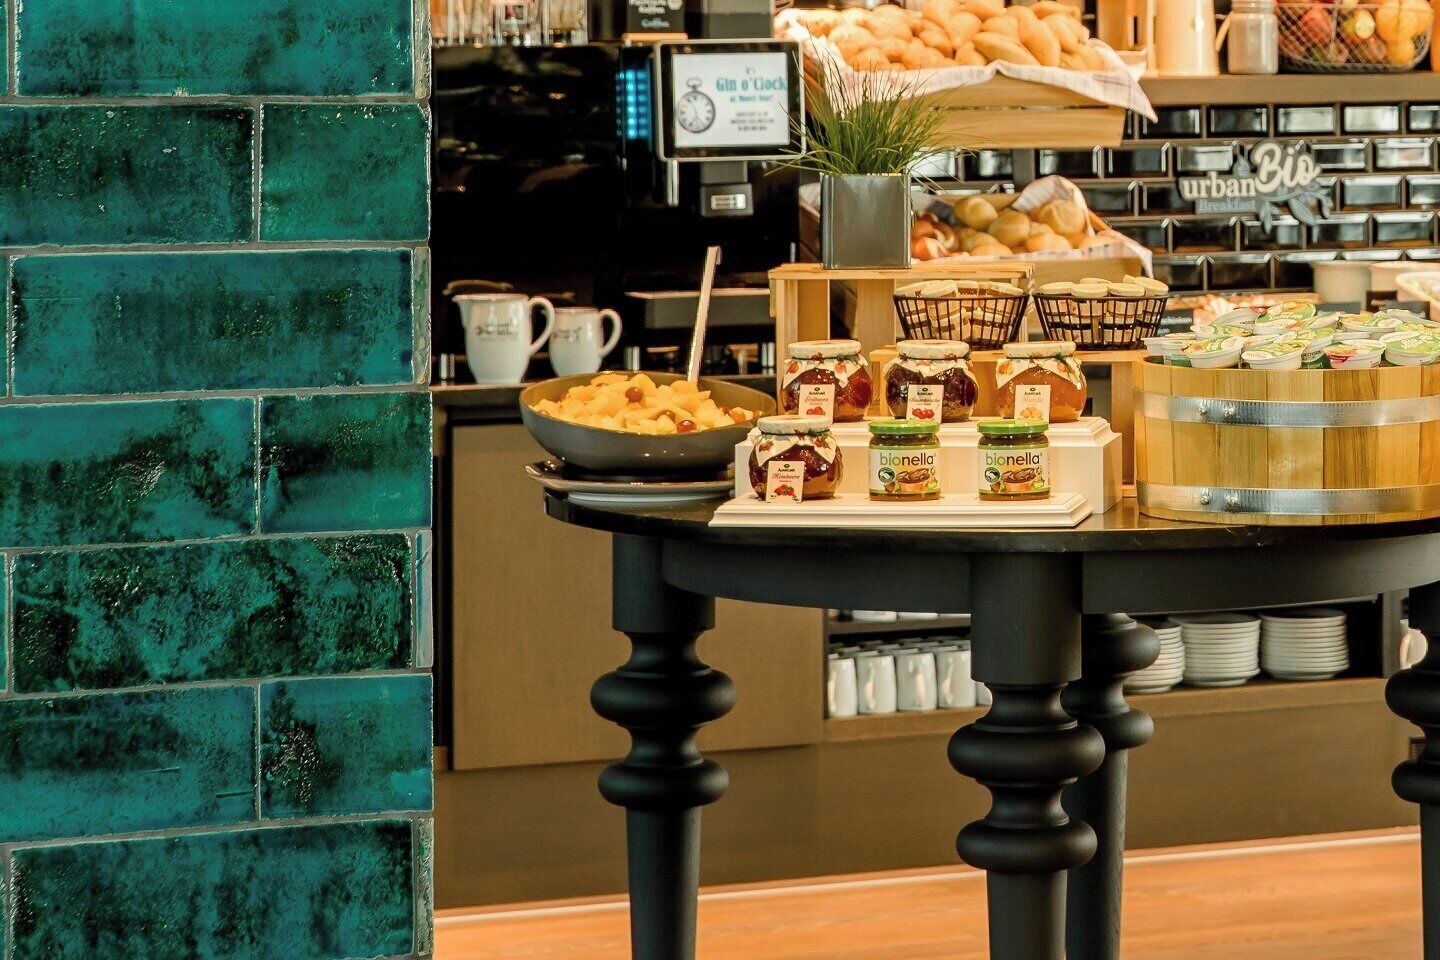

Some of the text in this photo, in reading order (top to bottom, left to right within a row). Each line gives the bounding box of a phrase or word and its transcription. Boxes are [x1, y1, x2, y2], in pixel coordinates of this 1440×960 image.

[716, 77, 736, 91] Gin
[1253, 142, 1322, 192] Bio
[1181, 171, 1256, 199] urban
[880, 452, 935, 466] bionella
[986, 452, 1040, 466] bionella
